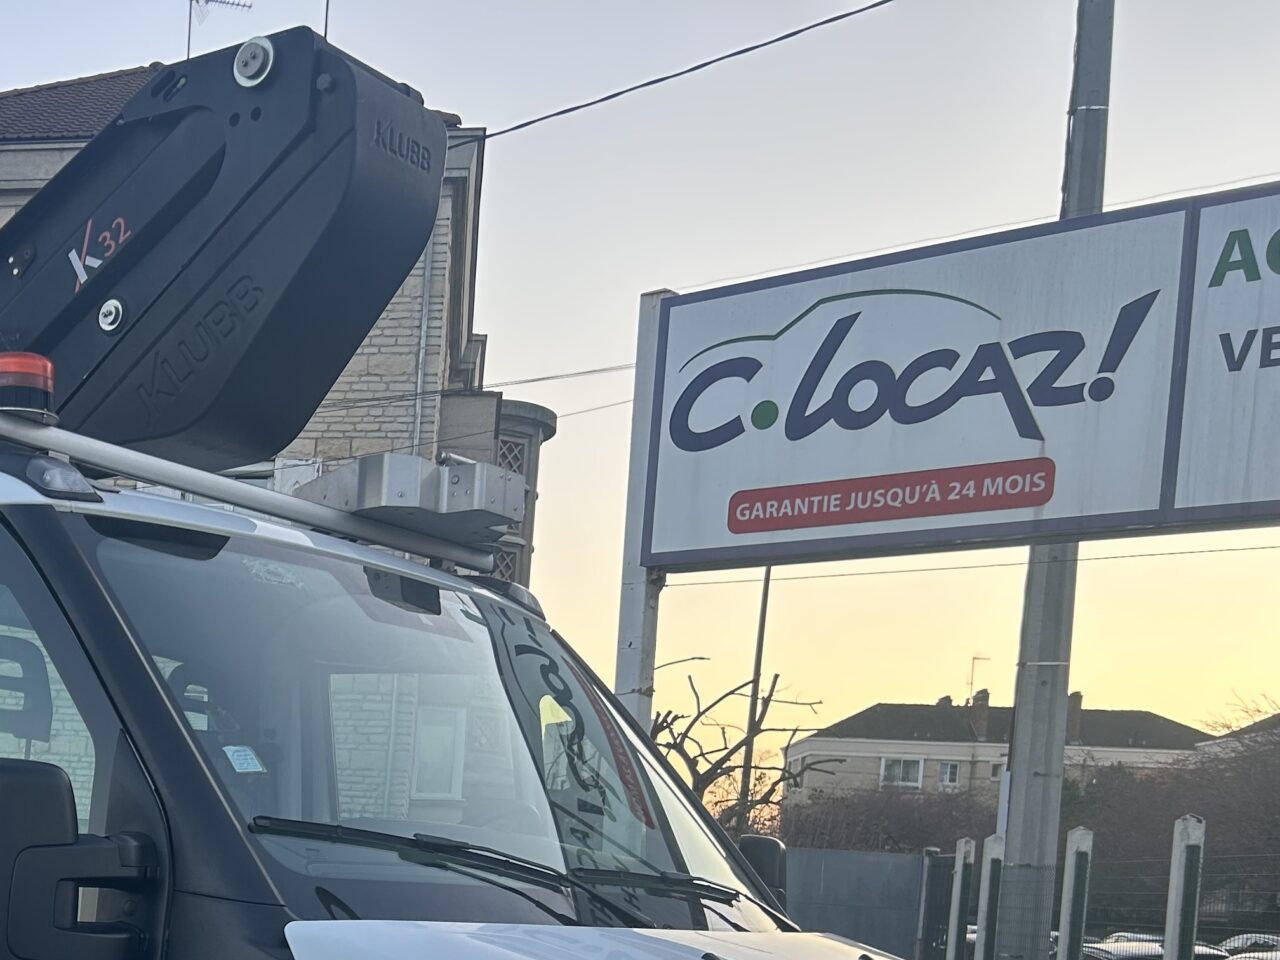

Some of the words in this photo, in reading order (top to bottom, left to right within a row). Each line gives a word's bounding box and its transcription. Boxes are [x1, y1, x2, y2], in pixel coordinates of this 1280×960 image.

[370, 118, 432, 174] KLUBB
[135, 274, 266, 430] KLUBB
[735, 494, 841, 521] GARANTIE
[947, 479, 976, 501] 24
[981, 471, 1047, 497] MOIS
